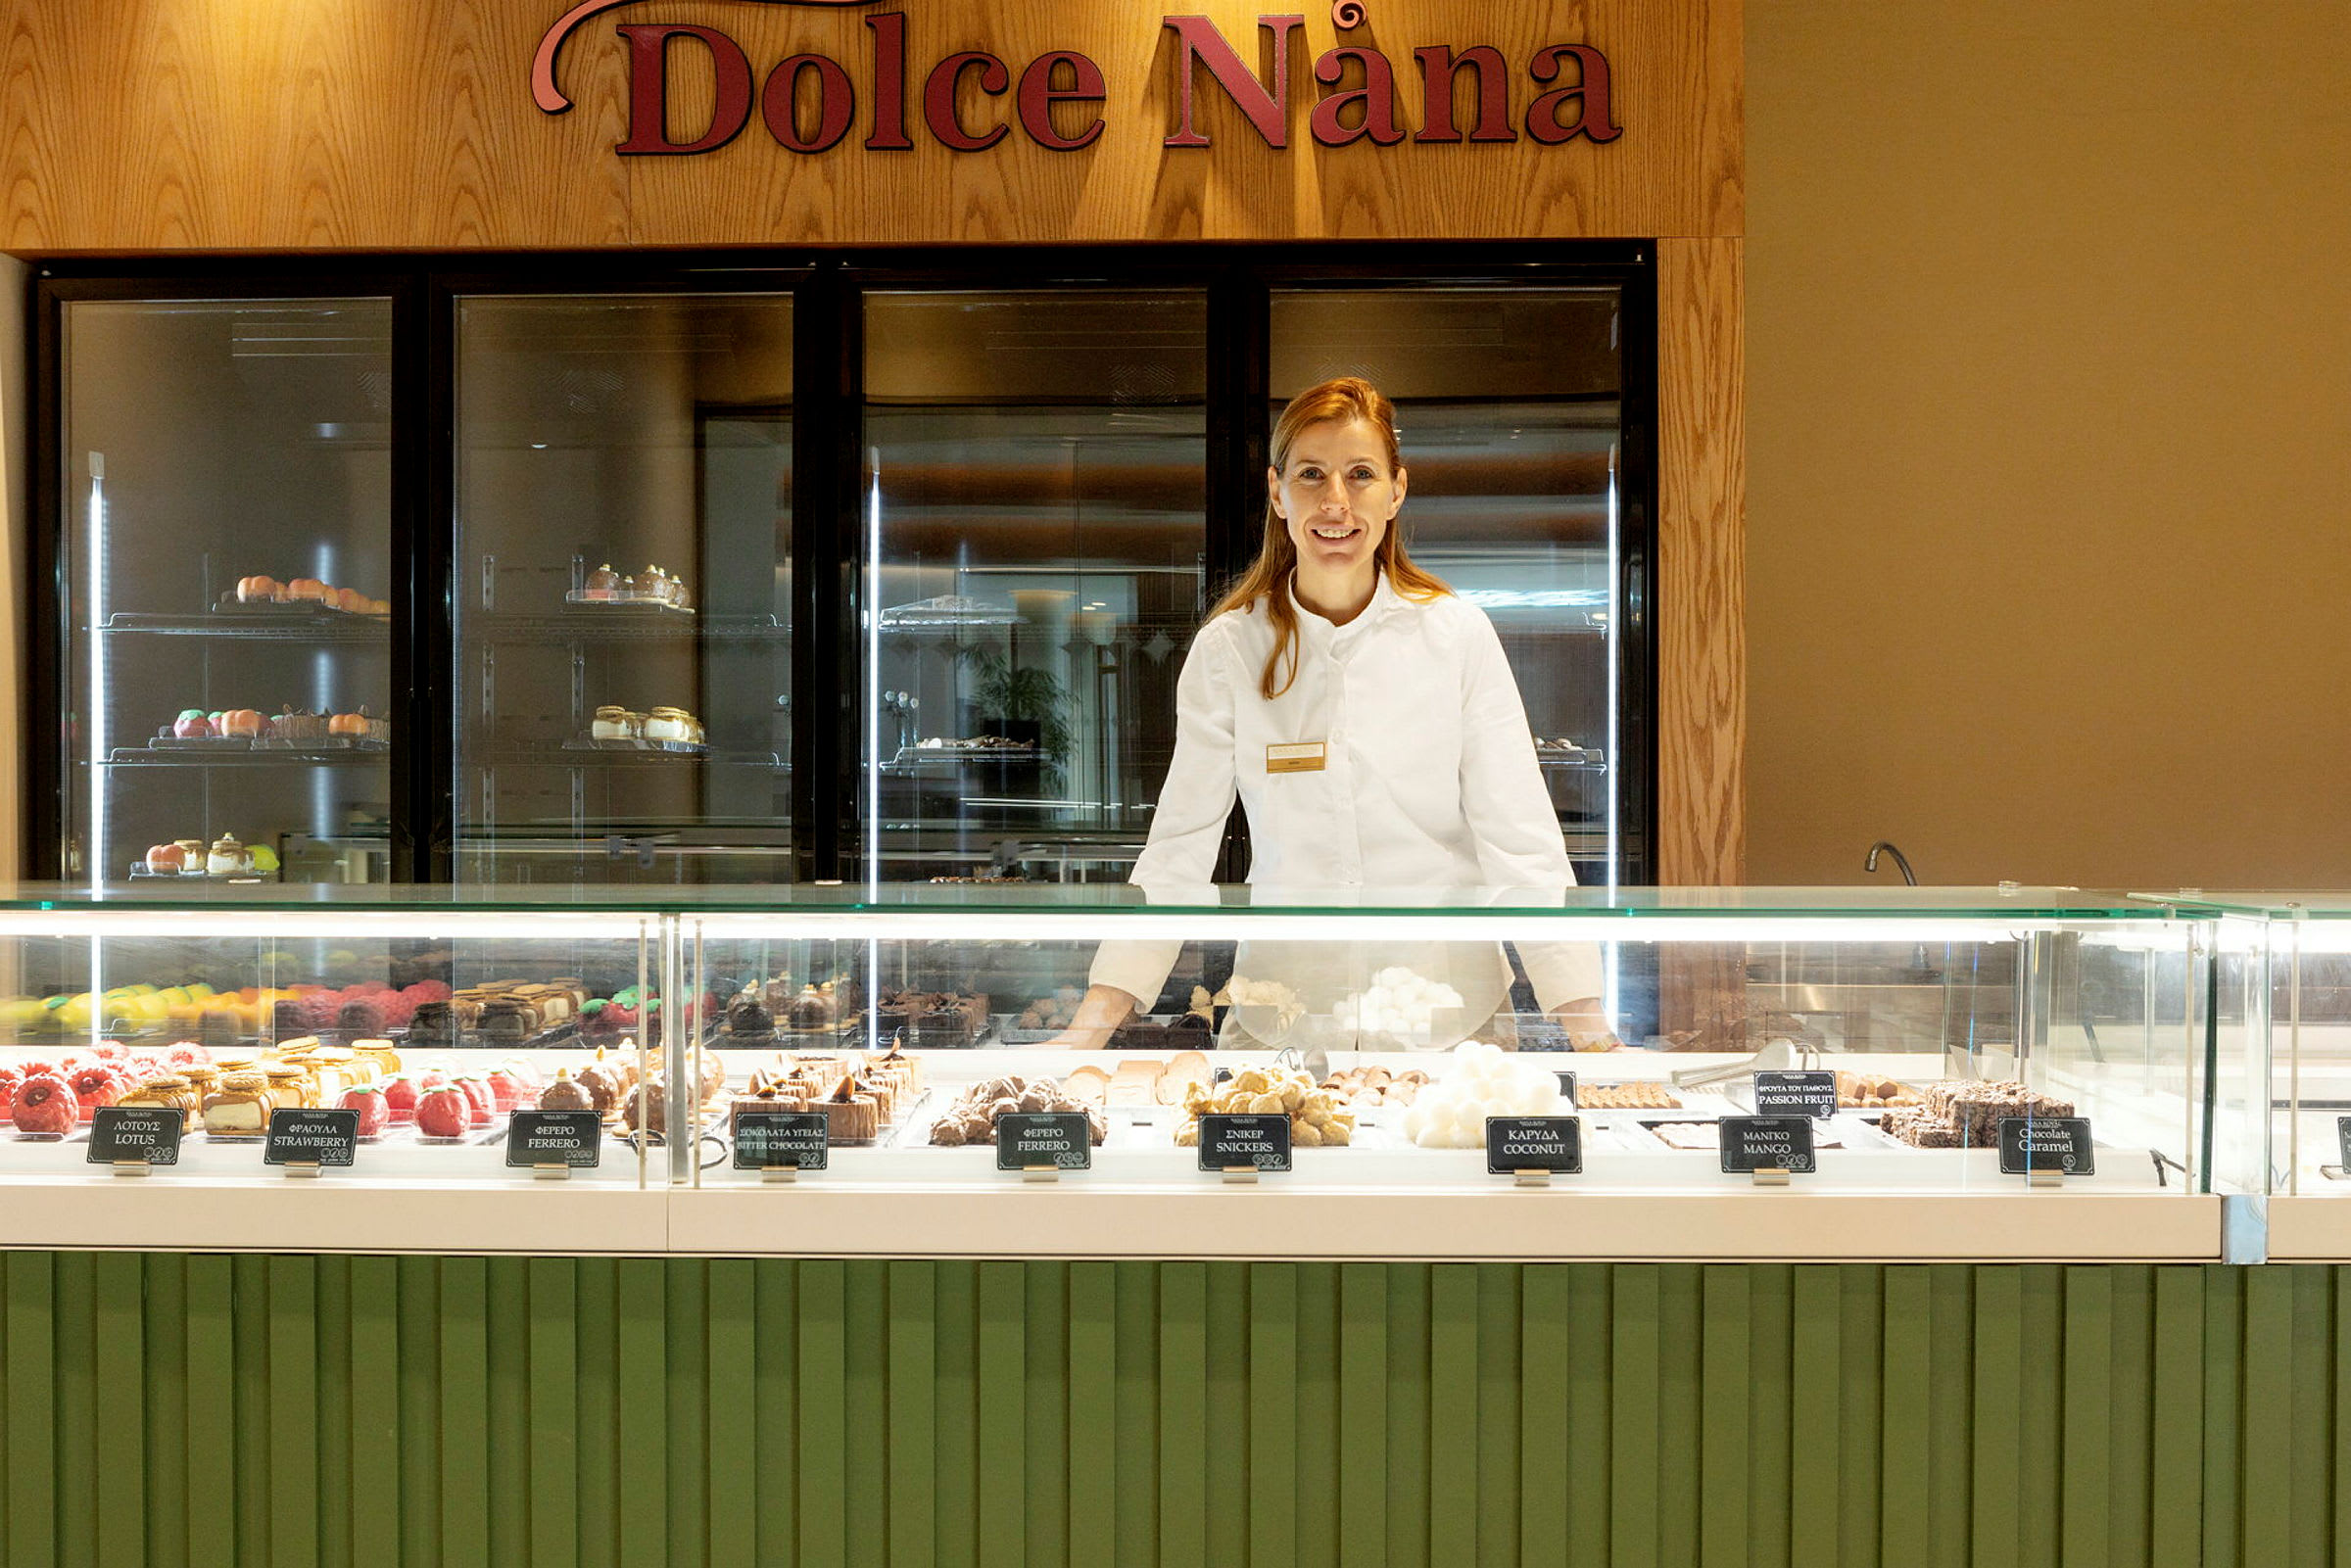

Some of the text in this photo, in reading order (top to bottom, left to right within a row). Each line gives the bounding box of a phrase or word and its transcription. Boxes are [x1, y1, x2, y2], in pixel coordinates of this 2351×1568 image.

[615, 12, 1623, 156] Dolce Nana
[1759, 1095, 1835, 1104] PASSION FRUIT
[114, 1121, 161, 1131] ΛΟΤΟΥΣ
[288, 1124, 337, 1134] ΦΡΑΟΥΛΑ
[534, 1126, 575, 1135] ΦΕΡΕΡΟ
[1023, 1128, 1064, 1137] ΦΕΡΕΡΟ
[1225, 1129, 1264, 1139] ΣΝΙΚΕΡ
[1509, 1130, 1559, 1140] ΚΑΡΥΔΑ
[1744, 1131, 1790, 1141] ΜΑΝΓΚΟ
[2019, 1128, 2071, 1139] Chocolate
[115, 1134, 156, 1145] LOTUS
[273, 1136, 349, 1147] STRAWBERRY
[528, 1138, 581, 1149] FERRERO
[737, 1141, 826, 1150] BITTER CHOCOLATE
[1017, 1140, 1071, 1151] FERRERO
[1216, 1142, 1273, 1153] SNICKERS
[1503, 1144, 1565, 1155] COCONUT
[1744, 1144, 1792, 1154] MANGO
[2018, 1140, 2074, 1152] Caramel
